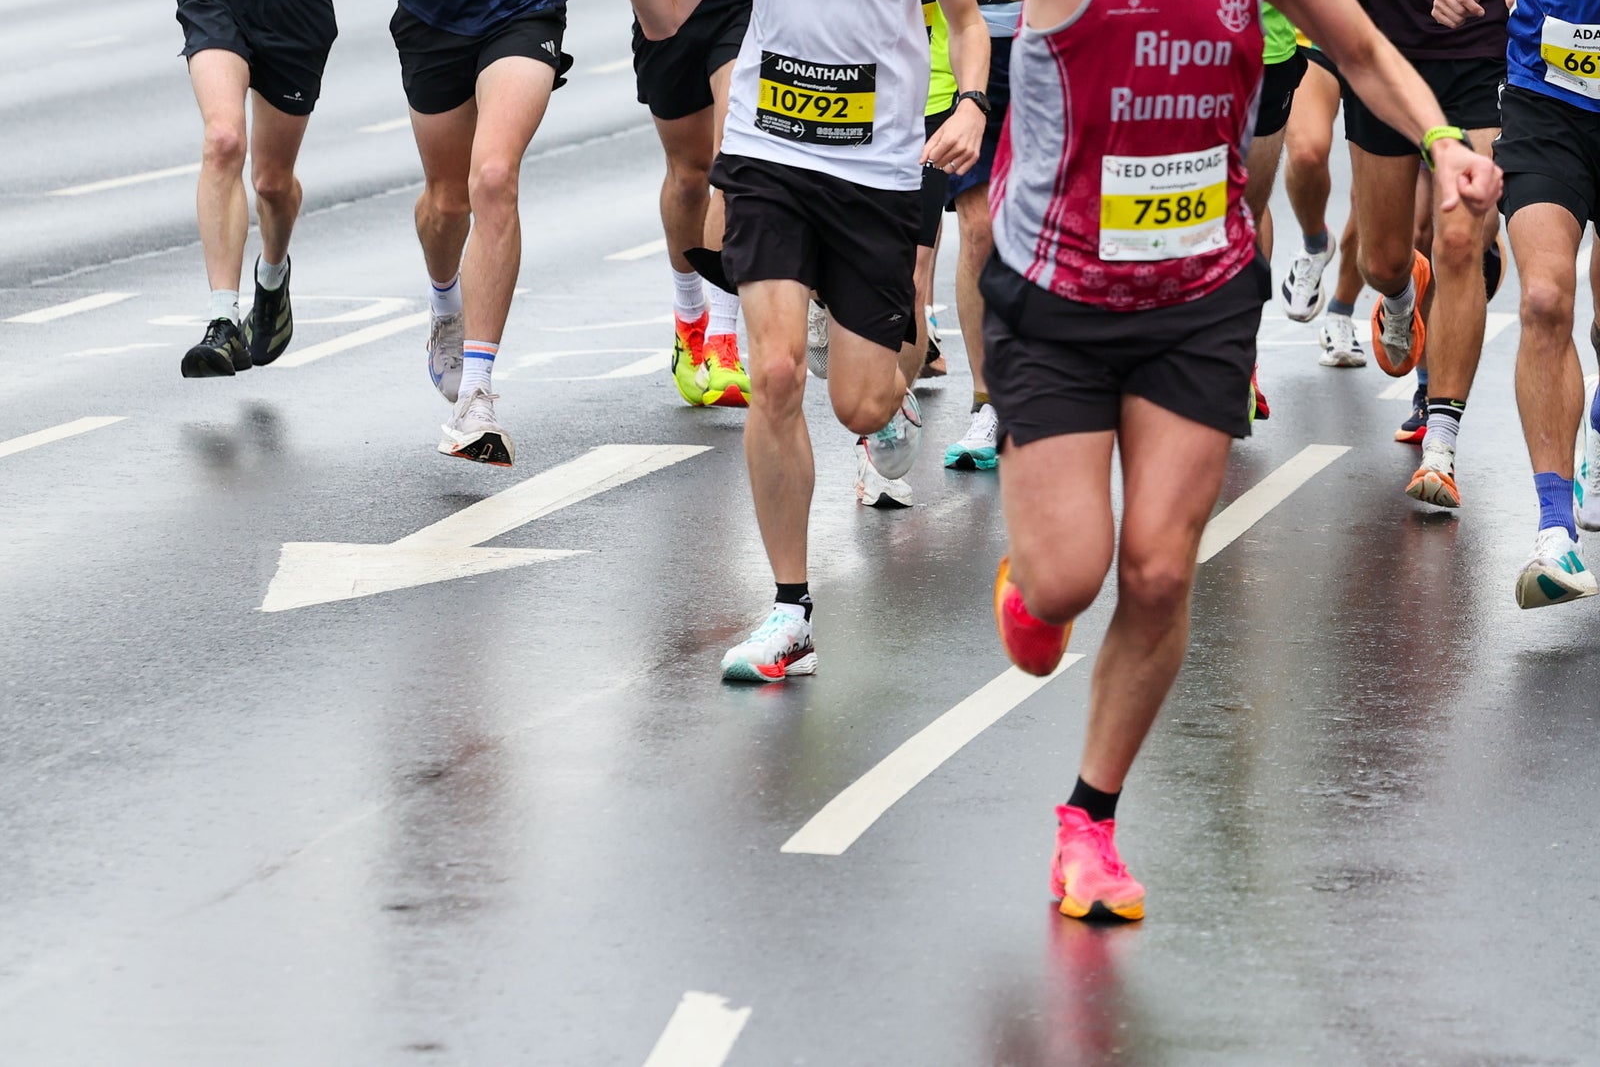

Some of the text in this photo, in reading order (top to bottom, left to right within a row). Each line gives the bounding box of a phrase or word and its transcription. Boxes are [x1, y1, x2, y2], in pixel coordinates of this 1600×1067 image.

[1135, 30, 1232, 75] Ripon
[775, 59, 859, 81] JONATHAN
[771, 85, 849, 119] 10792
[1110, 87, 1233, 122] Runners
[1134, 192, 1206, 225] 7586
